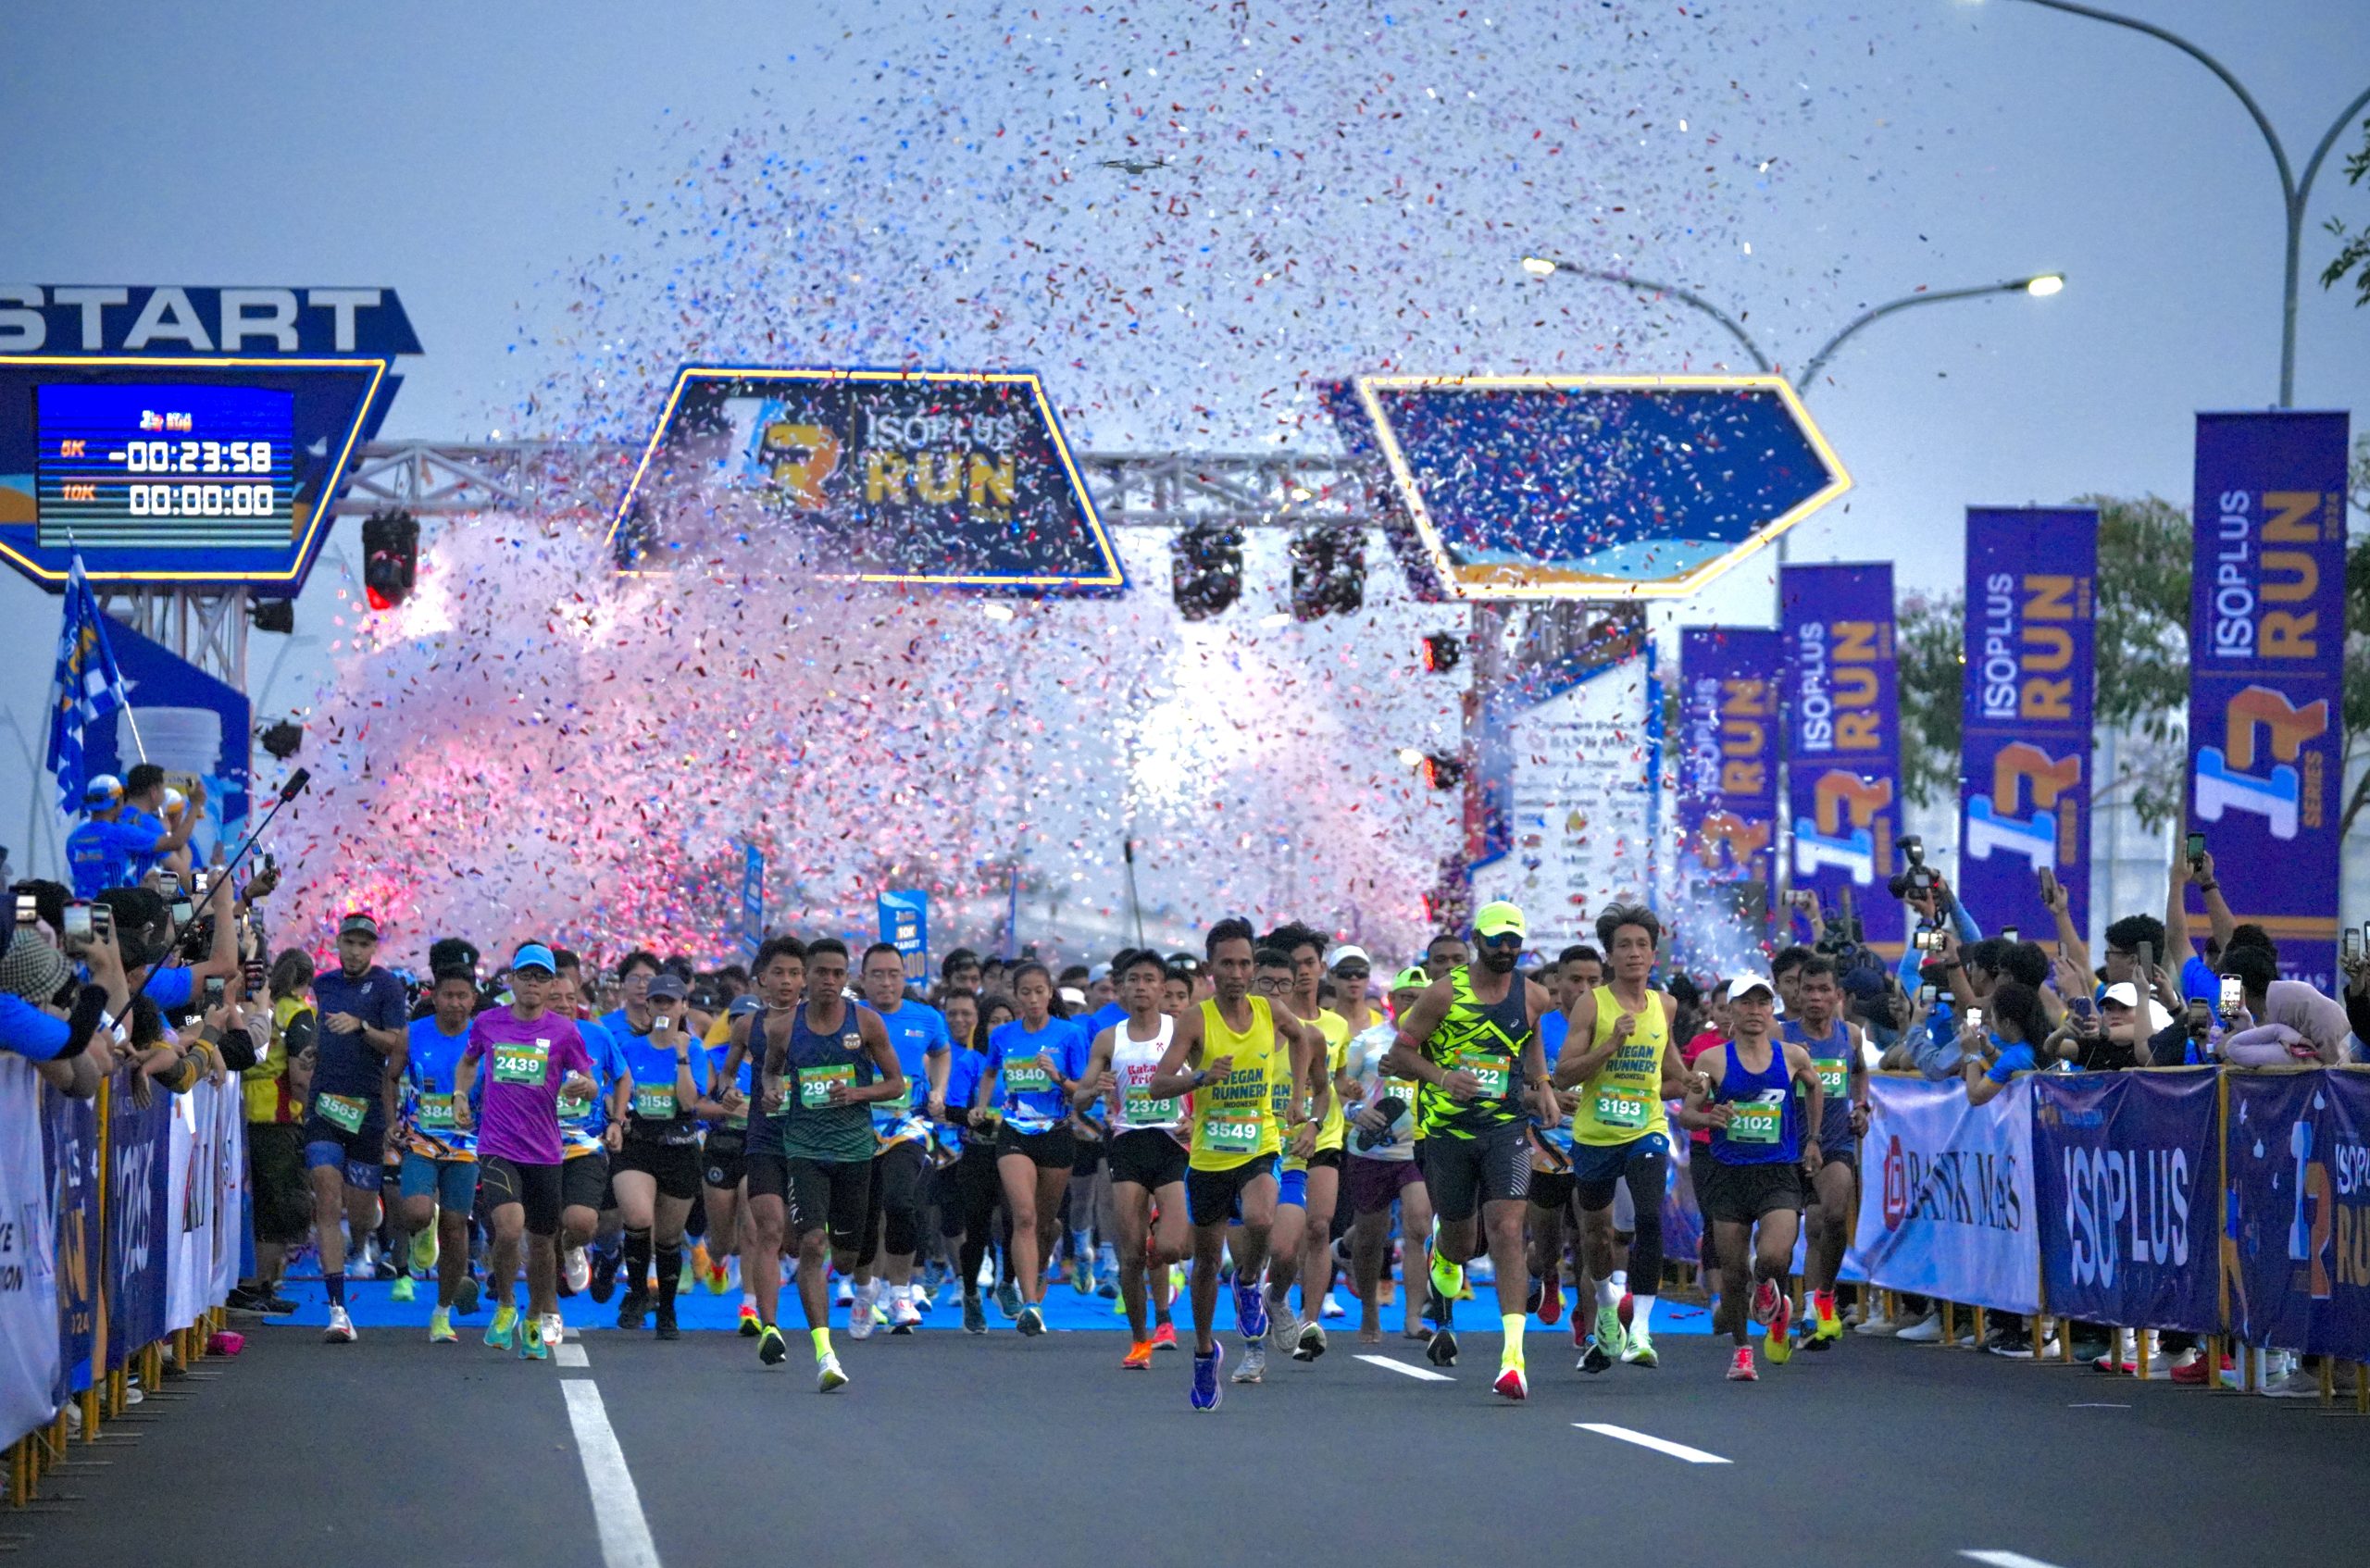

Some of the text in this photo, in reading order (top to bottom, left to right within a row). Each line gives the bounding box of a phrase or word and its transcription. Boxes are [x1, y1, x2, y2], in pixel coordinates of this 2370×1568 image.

[0, 286, 380, 351] START
[867, 414, 1017, 448] ISOPLUS
[61, 441, 271, 473] 5K -00:23:58
[867, 451, 1016, 505] RUN
[62, 484, 273, 516] 10K 00:00:00
[2324, 492, 2339, 541] 2024
[2214, 491, 2255, 657] ISOPLUS
[2258, 491, 2322, 658] RUN
[1984, 572, 2017, 719] ISOPLUS
[2020, 574, 2076, 719] RUN
[1801, 621, 1832, 751] ISOPLUS
[1831, 621, 1880, 750] RUN
[1694, 678, 1723, 794] ISOPLUS
[1723, 679, 1765, 793] RUN
[2302, 751, 2323, 828] SERIES
[496, 1056, 539, 1072] 2439
[1605, 1059, 1657, 1074] RUNNERS
[1617, 1045, 1654, 1058] VEGAN
[1006, 1068, 1045, 1081] 3840
[319, 1096, 358, 1120] 3563
[639, 1095, 672, 1108] 3158
[1129, 1099, 1170, 1113] 2378
[1599, 1098, 1640, 1115] 3193
[1206, 1121, 1256, 1139] 3549
[1731, 1116, 1772, 1129] 2102
[2064, 1146, 2189, 1288] ISOPLUS
